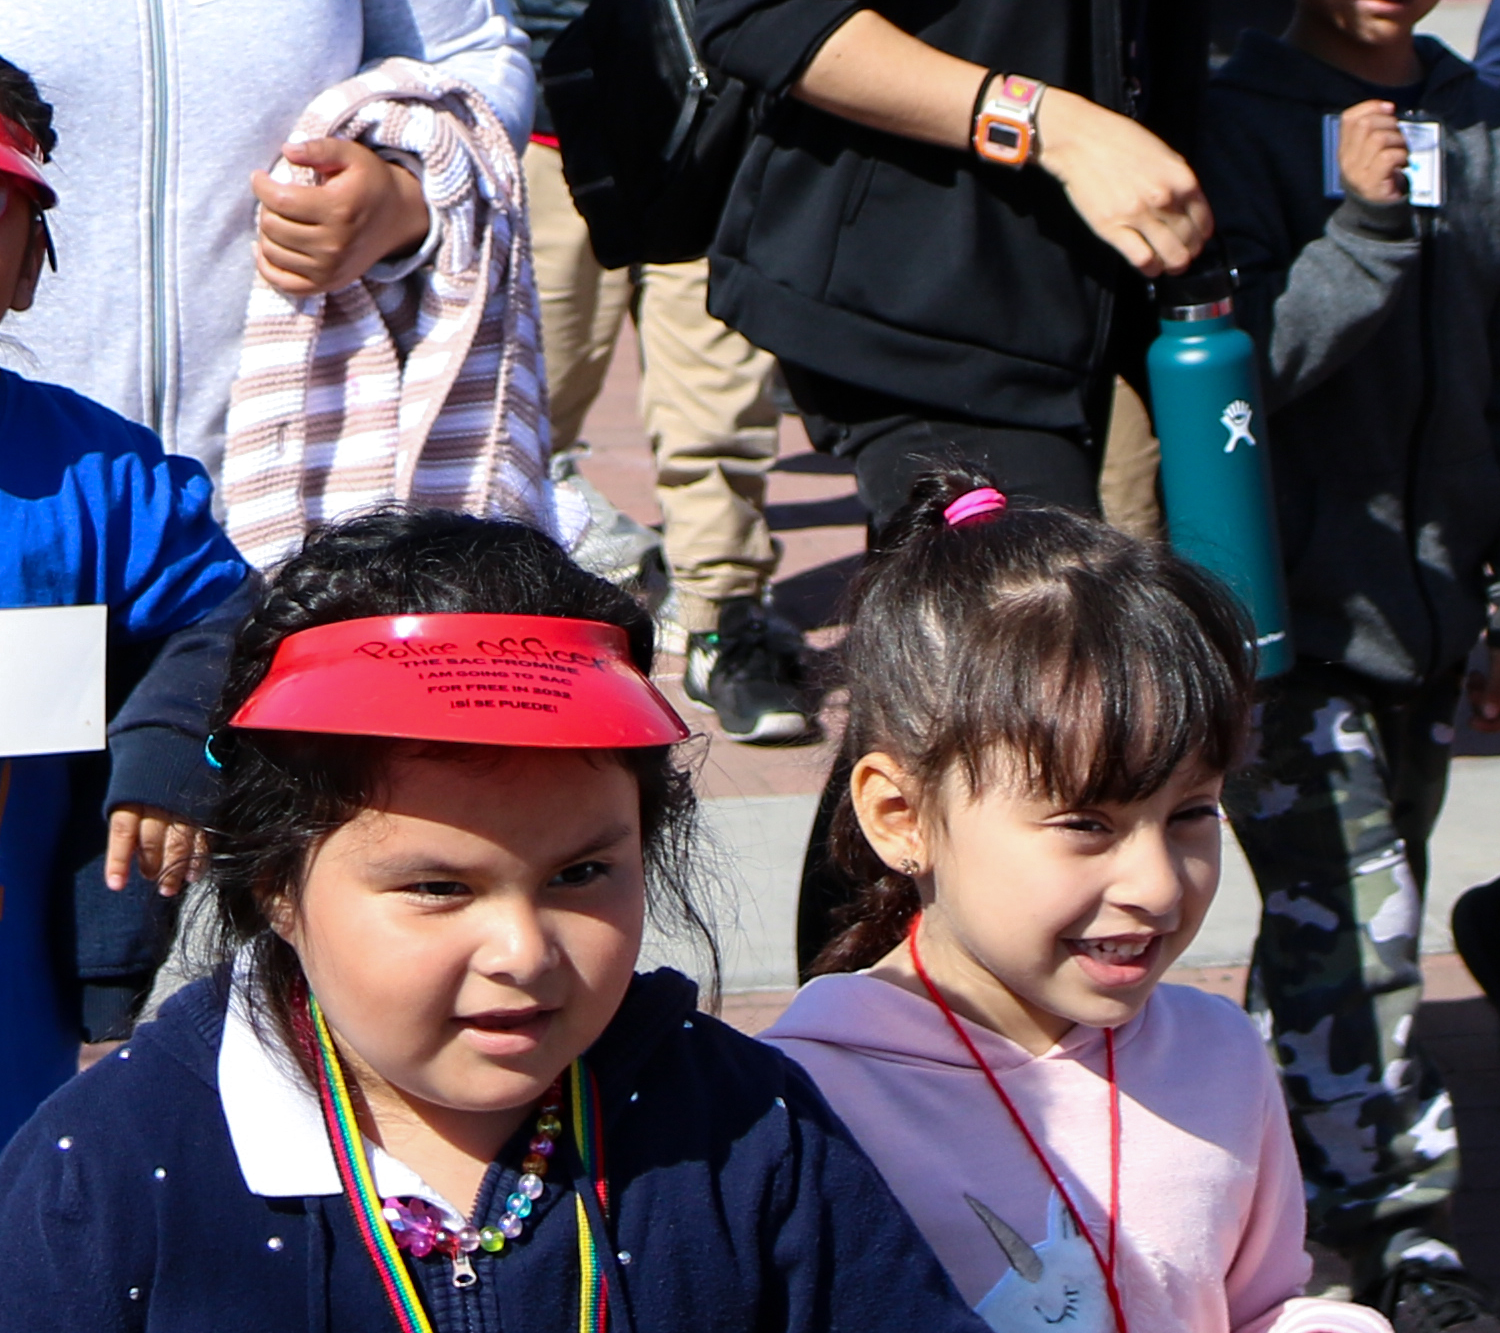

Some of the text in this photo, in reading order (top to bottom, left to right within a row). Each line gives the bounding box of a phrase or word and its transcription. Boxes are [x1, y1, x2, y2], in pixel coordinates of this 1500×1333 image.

[353, 637, 612, 672] Police Officer
[399, 658, 581, 675] THE SAC PROMISE
[427, 670, 453, 679] AM
[456, 670, 510, 679] GOING
[512, 671, 535, 680] TO
[539, 674, 573, 686] SAC
[427, 684, 463, 694] FOR
[466, 683, 511, 694] FREE
[512, 685, 530, 694] IN
[474, 699, 497, 709] SE
